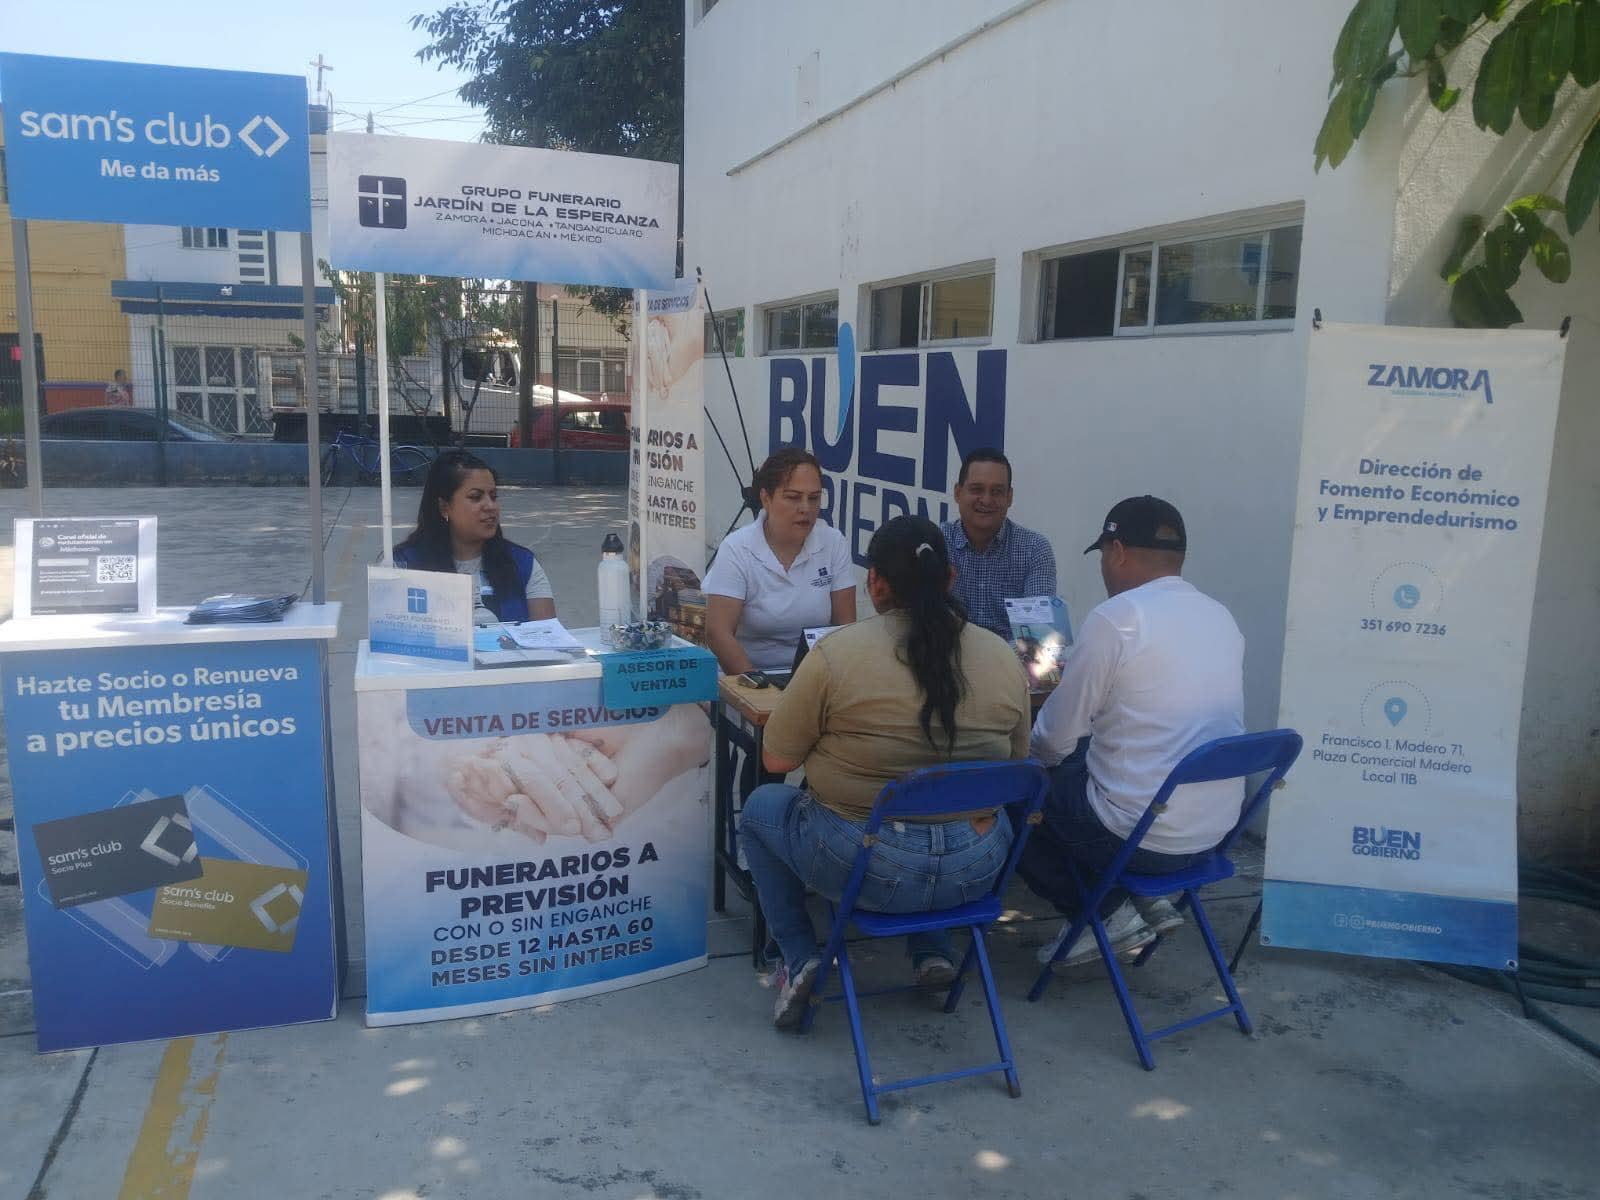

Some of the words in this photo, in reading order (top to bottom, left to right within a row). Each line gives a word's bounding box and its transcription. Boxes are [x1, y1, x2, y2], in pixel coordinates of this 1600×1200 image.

[20, 110, 135, 142] sam's
[145, 112, 231, 148] club
[101, 159, 136, 178] Me
[141, 162, 169, 180] da
[176, 164, 220, 182] más
[461, 185, 521, 200] GRUPO
[528, 191, 621, 209] FUNERARIO
[413, 195, 483, 212] JARDÍN
[491, 201, 516, 214] DE
[525, 204, 548, 217] LA
[556, 208, 659, 229] ESPERANZA
[435, 212, 487, 224] ZAMORA
[496, 216, 543, 228] JACONA
[560, 231, 602, 245] MÉXICO
[1367, 364, 1493, 404] ZAMORA
[769, 349, 1007, 493] BUEN
[686, 433, 698, 450] A
[1359, 458, 1452, 480] Dirección
[1457, 464, 1483, 482] de
[1319, 479, 1404, 500] Fomento
[1410, 485, 1520, 508] Económico
[681, 500, 696, 514] 60
[1317, 505, 1329, 522] y
[1333, 504, 1518, 531] Emprendedurismo
[652, 511, 697, 530] INTERES
[1360, 618, 1383, 632] 351
[1386, 620, 1411, 634] 690
[1415, 622, 1447, 636] 7236
[617, 659, 675, 675] ASESOR
[679, 658, 698, 670] DE
[16, 674, 92, 697] Hazte
[98, 670, 166, 692] Socio
[172, 673, 188, 688] o
[193, 665, 298, 687] Renueva
[631, 677, 688, 693] VENTAS
[58, 699, 90, 722] tu
[97, 689, 262, 719] Membresía
[27, 734, 47, 753] a
[56, 719, 182, 757] precios
[190, 713, 296, 742] únicos
[424, 712, 506, 737] VENTA
[511, 711, 545, 732] DE
[1321, 733, 1382, 750] Francisco
[1395, 740, 1447, 755] Madero
[1313, 749, 1347, 764] Plaza
[1351, 752, 1416, 770] Comercial
[1419, 758, 1472, 775] Madero
[1362, 770, 1396, 784] Local
[1352, 825, 1421, 850] BUEN
[48, 848, 89, 866] sam's
[91, 840, 122, 857] club
[1352, 844, 1421, 861] GOBIERNO
[51, 864, 75, 875] Socio
[75, 860, 93, 870] Plus
[425, 846, 632, 893] FUNERARIOS
[637, 842, 660, 863] A
[159, 897, 183, 907] Socio
[183, 900, 216, 911] Benefits
[163, 885, 201, 900] sam's
[204, 889, 235, 904] club
[460, 874, 630, 920] PREVISIÓN
[433, 923, 482, 942] CON
[488, 921, 505, 937] O
[511, 915, 544, 934] SIN
[551, 895, 653, 929] ENGANCHE
[431, 941, 512, 967] DESDE
[518, 936, 541, 955] 12
[549, 923, 621, 951] HASTA
[627, 917, 654, 936] 60
[431, 962, 512, 988] MESES
[518, 952, 557, 977] SIN
[563, 937, 654, 969] INTERES
